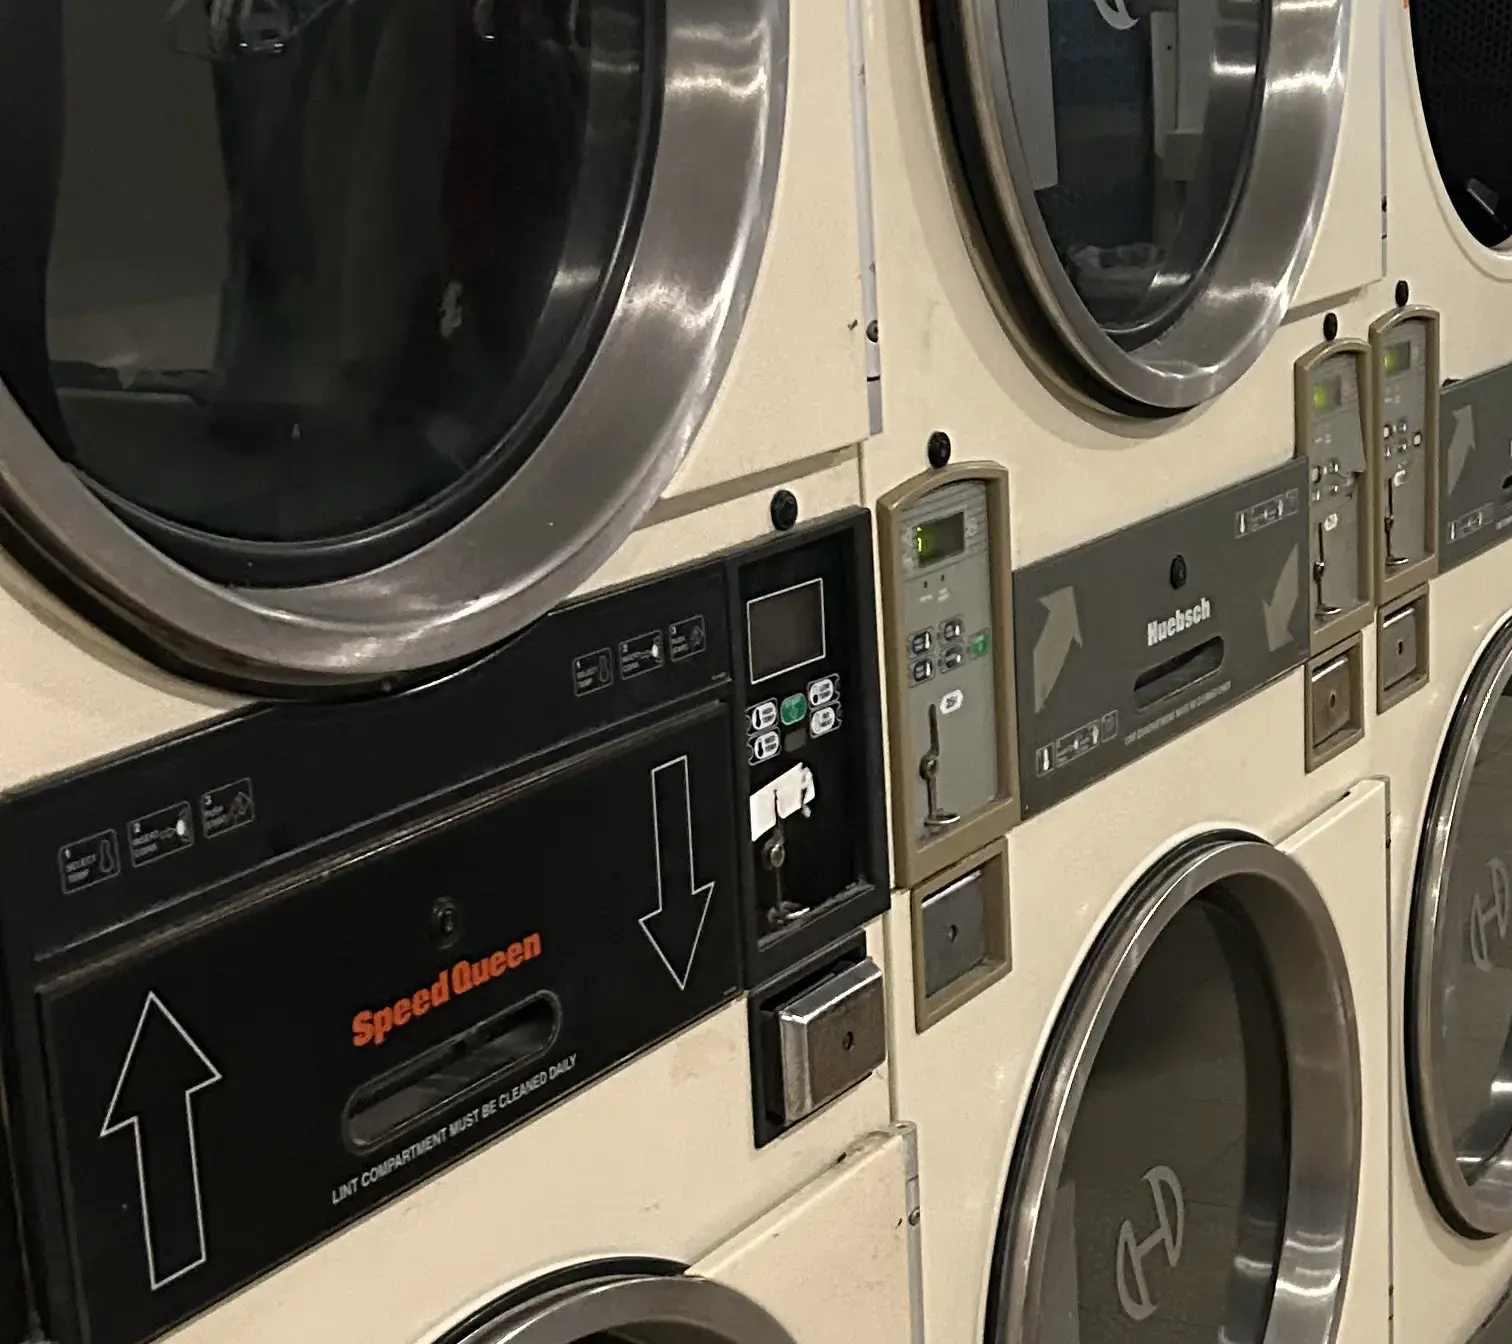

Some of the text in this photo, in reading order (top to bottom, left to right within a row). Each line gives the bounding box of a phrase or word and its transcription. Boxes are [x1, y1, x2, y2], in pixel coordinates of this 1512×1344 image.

[1147, 597, 1211, 646] Huebsch
[352, 932, 542, 1047] Speed Queen
[332, 1053, 577, 1205] LINT COMPARTMENT MUST BE CLEANED DAILY
